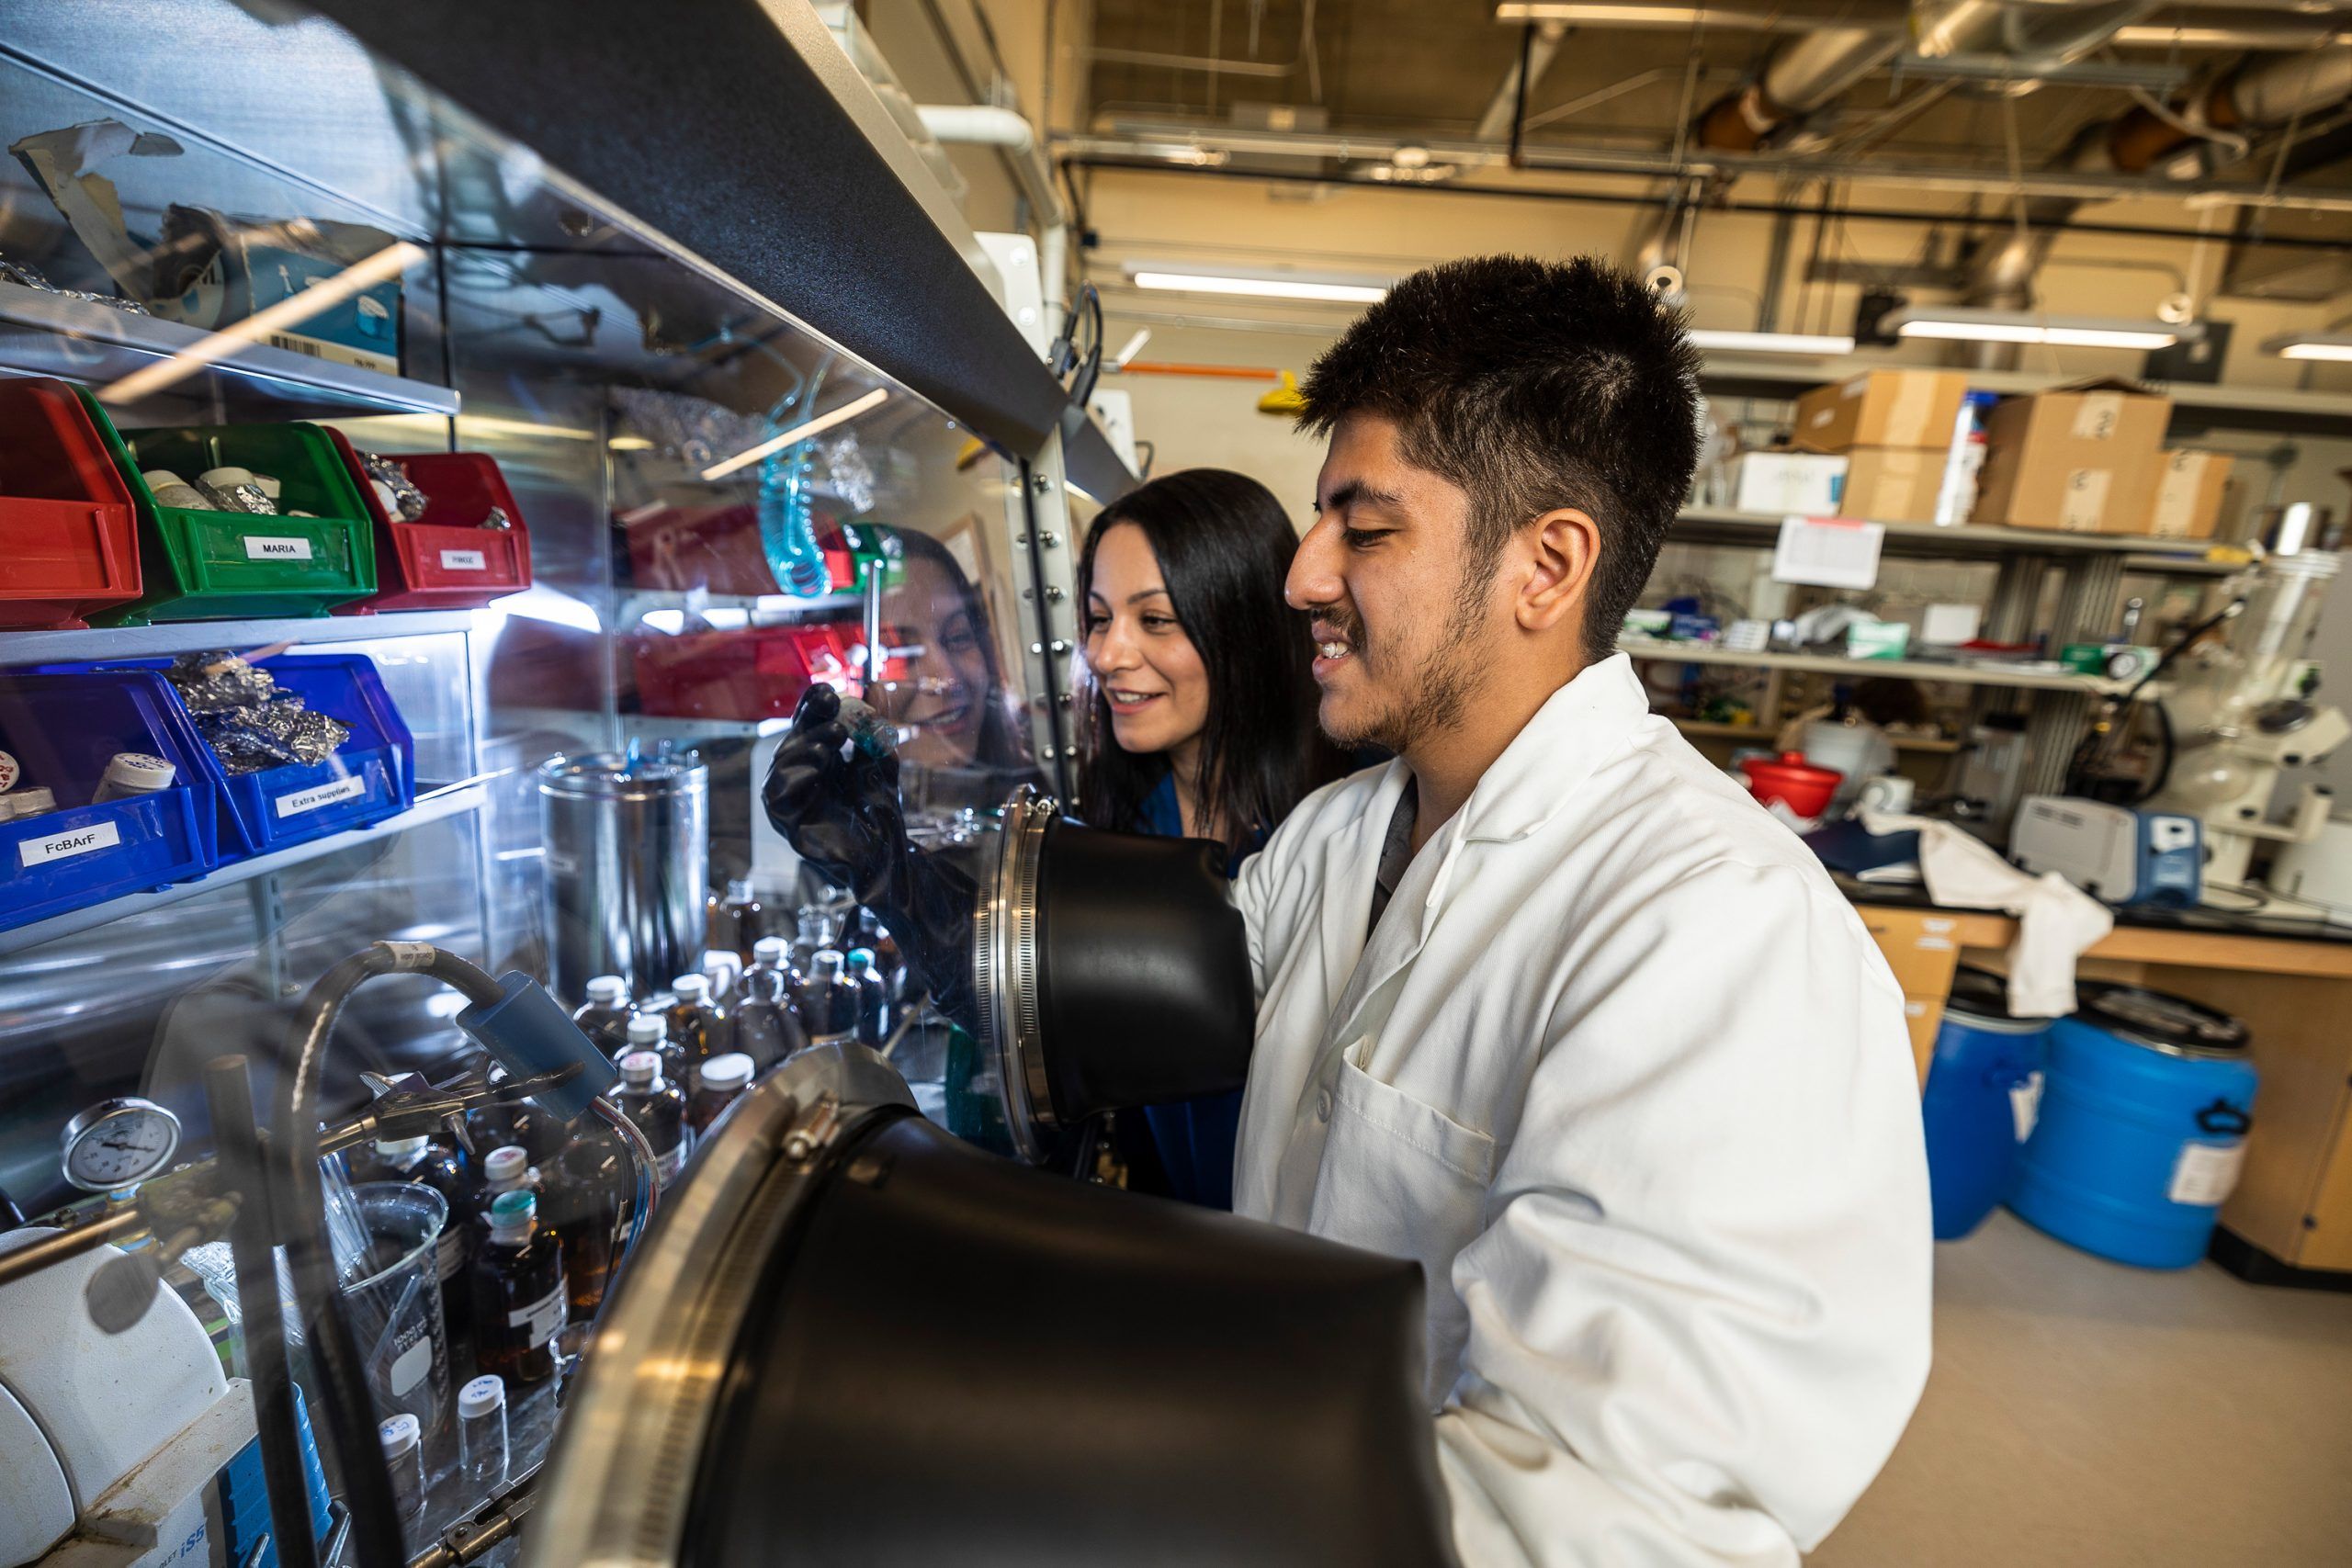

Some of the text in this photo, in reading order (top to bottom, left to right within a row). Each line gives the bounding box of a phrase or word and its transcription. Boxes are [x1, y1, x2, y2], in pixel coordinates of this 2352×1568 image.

[263, 545, 296, 553] MARIA
[292, 785, 351, 807] Extra supplies
[45, 833, 96, 854] FcBArF
